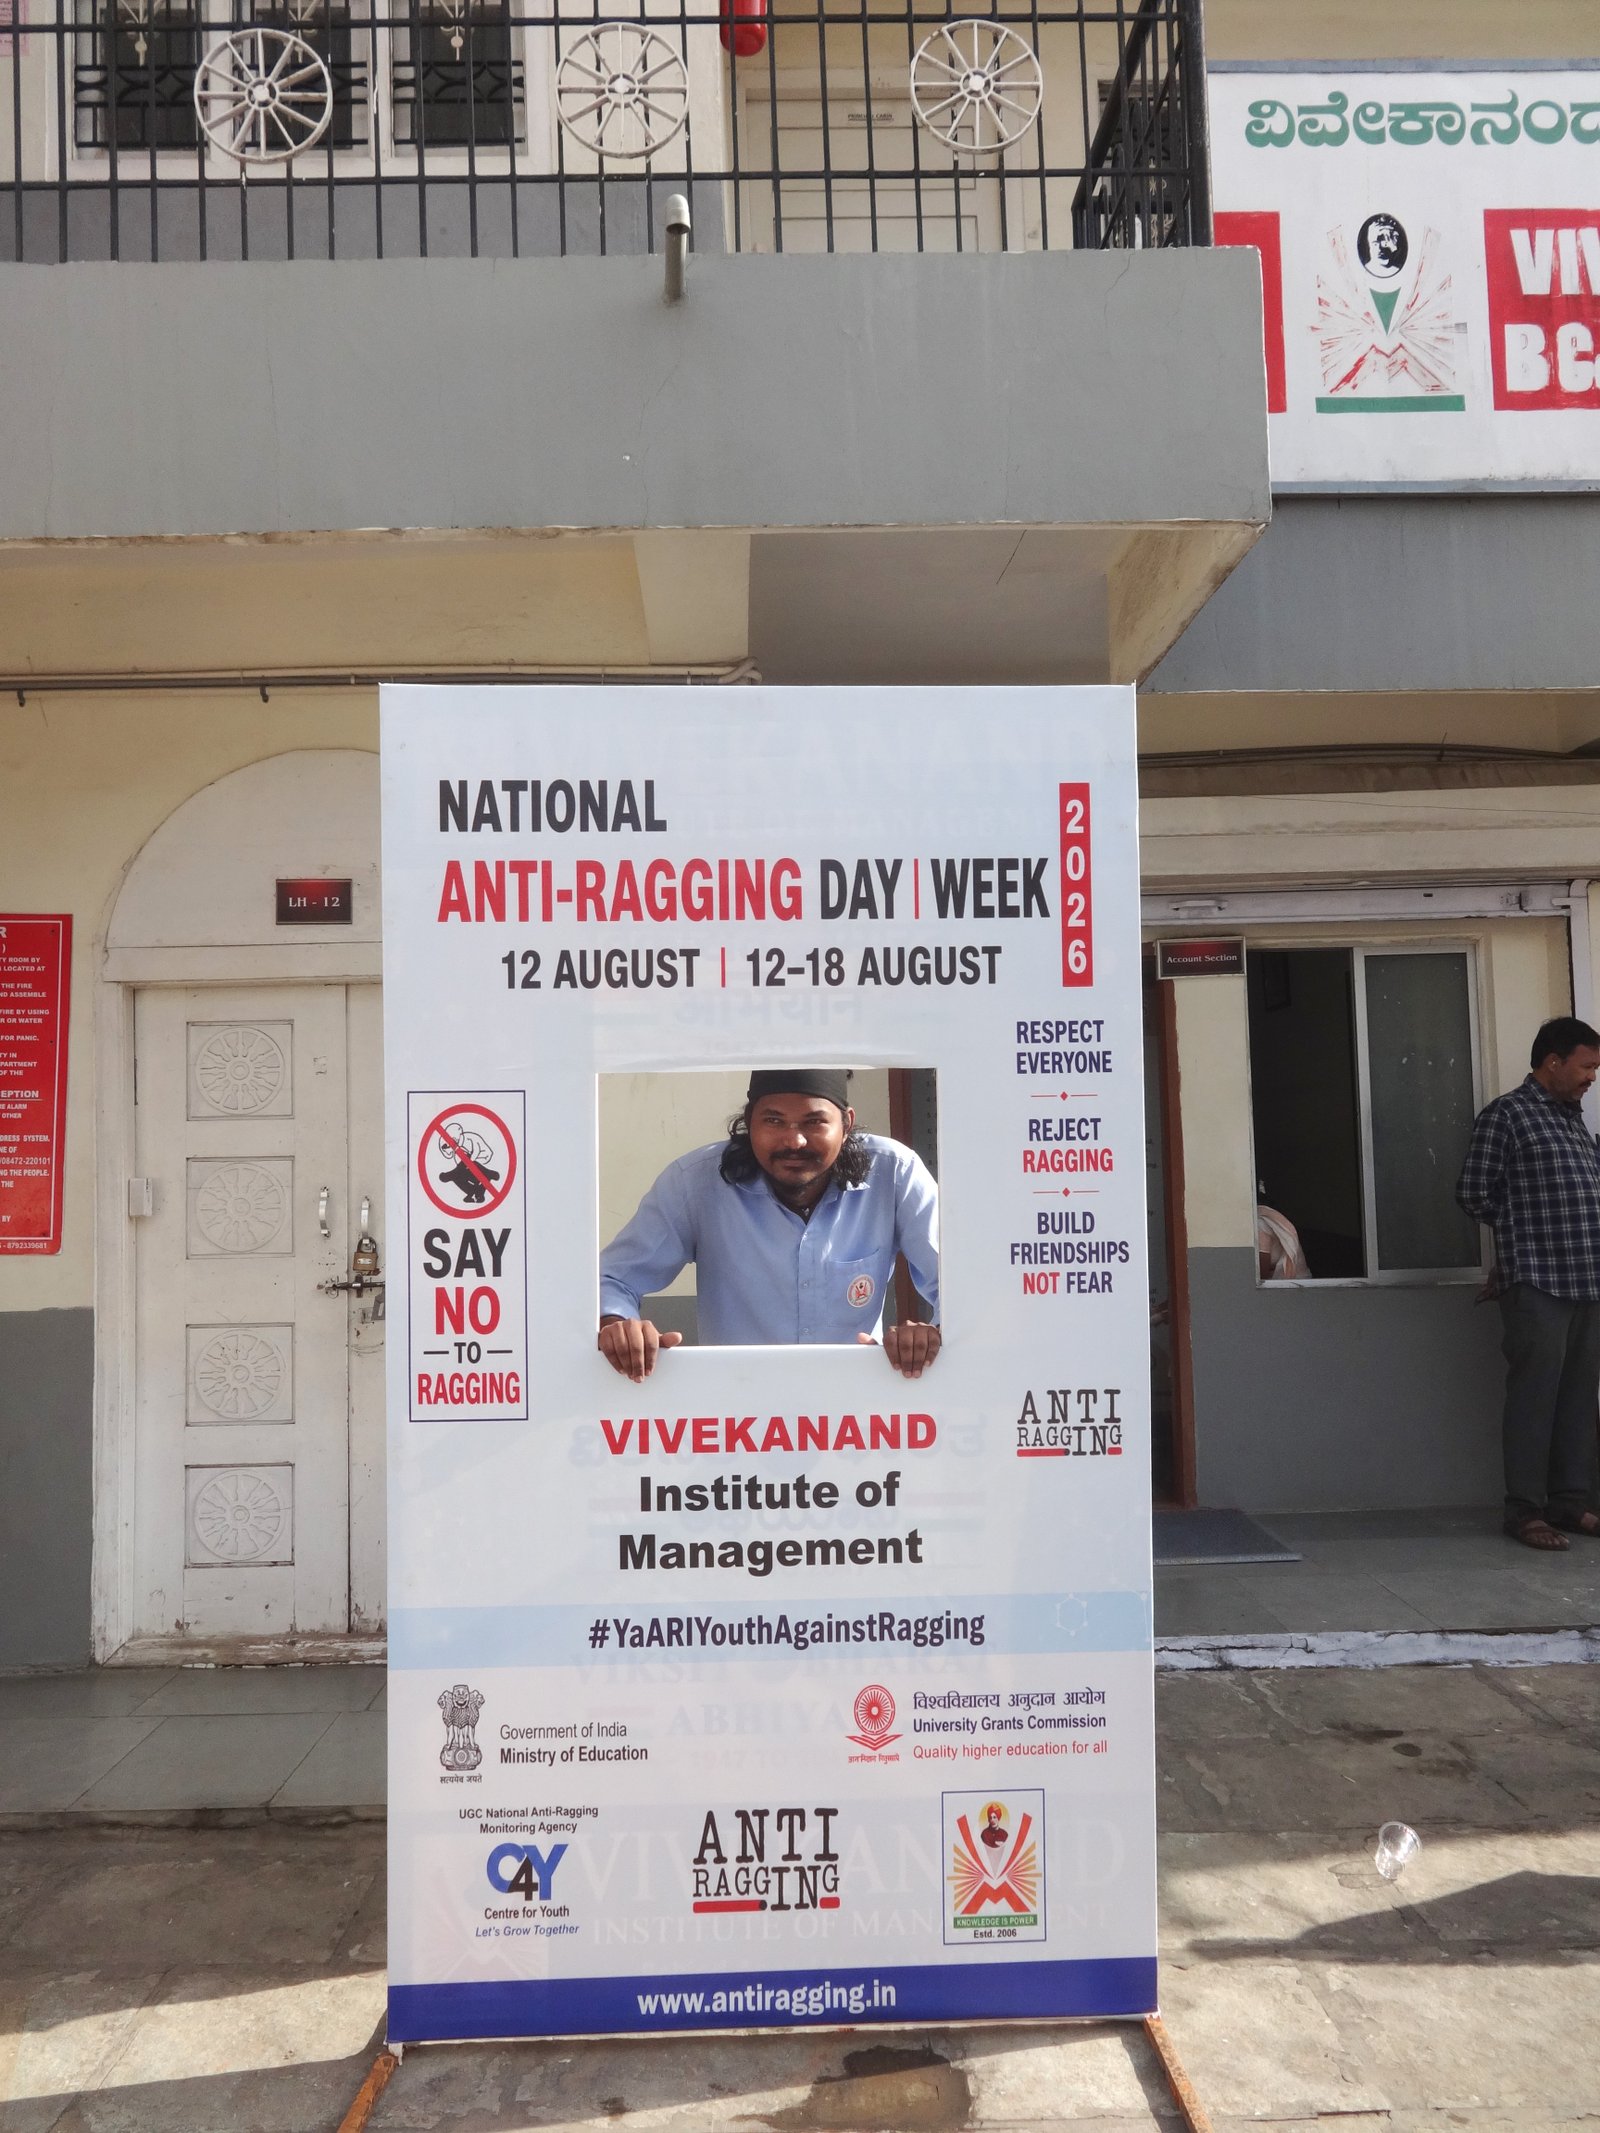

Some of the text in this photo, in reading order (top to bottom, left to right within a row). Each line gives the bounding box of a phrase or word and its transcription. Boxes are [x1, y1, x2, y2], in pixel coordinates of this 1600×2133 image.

[440, 779, 667, 833] NATIONAL
[438, 858, 1050, 922] ANTI-RAGGING DAY WEEK
[1066, 799, 1087, 974] 2026
[288, 896, 307, 907] LH
[324, 896, 341, 907] 12
[502, 950, 541, 989] 12
[553, 948, 700, 989] AUGUST
[858, 946, 1002, 985] AUGUST
[1166, 954, 1238, 964] Account Section
[1017, 1020, 1104, 1043] RESPECT
[1017, 1051, 1112, 1074] EVERYONE
[1029, 1118, 1101, 1141] REJECT
[1023, 1148, 1113, 1173] RAGGING
[1038, 1212, 1095, 1234] BUILD
[423, 1228, 511, 1279] SAY
[1011, 1241, 1129, 1264] FRIENDSHIPS
[1023, 1271, 1112, 1294] NOT FEAR
[436, 1286, 500, 1335] NO
[454, 1342, 481, 1364] TO
[418, 1372, 520, 1405] RAGGING
[1017, 1389, 1121, 1427] ANTI
[600, 1414, 936, 1455] VIVEKANAND
[1016, 1425, 1122, 1456] RAGGING
[641, 1471, 901, 1512] Institute of
[620, 1529, 923, 1577] Management
[589, 1610, 984, 1650] #YaARIYouthAgainstRagging
[913, 1687, 1105, 1711] विश्वविद्यालय अनुदान आयोग
[500, 1722, 627, 1740] Government of India
[914, 1714, 1106, 1734] University Grants Commission
[501, 1745, 647, 1766] Ministry of Education
[914, 1745, 957, 1760] Quality
[963, 1744, 1002, 1760] higher
[1007, 1742, 1067, 1756] education
[1072, 1741, 1089, 1753] for
[1093, 1740, 1107, 1753] all
[460, 1806, 598, 1819] UGC National Anti-Ragging
[480, 1822, 577, 1835] Monitoring Agency
[693, 1808, 839, 1867] ANTI
[486, 1842, 569, 1901] C4Y
[692, 1864, 840, 1911] RAGGING
[485, 1905, 569, 1919] Centre for Youth
[956, 1916, 1035, 1927] KNOWLEDGE IS POWER
[476, 1924, 579, 1937] Let's Grow Together
[971, 1927, 1016, 1938] Estd. 2006
[636, 1981, 898, 2020] www.antiragging.in
